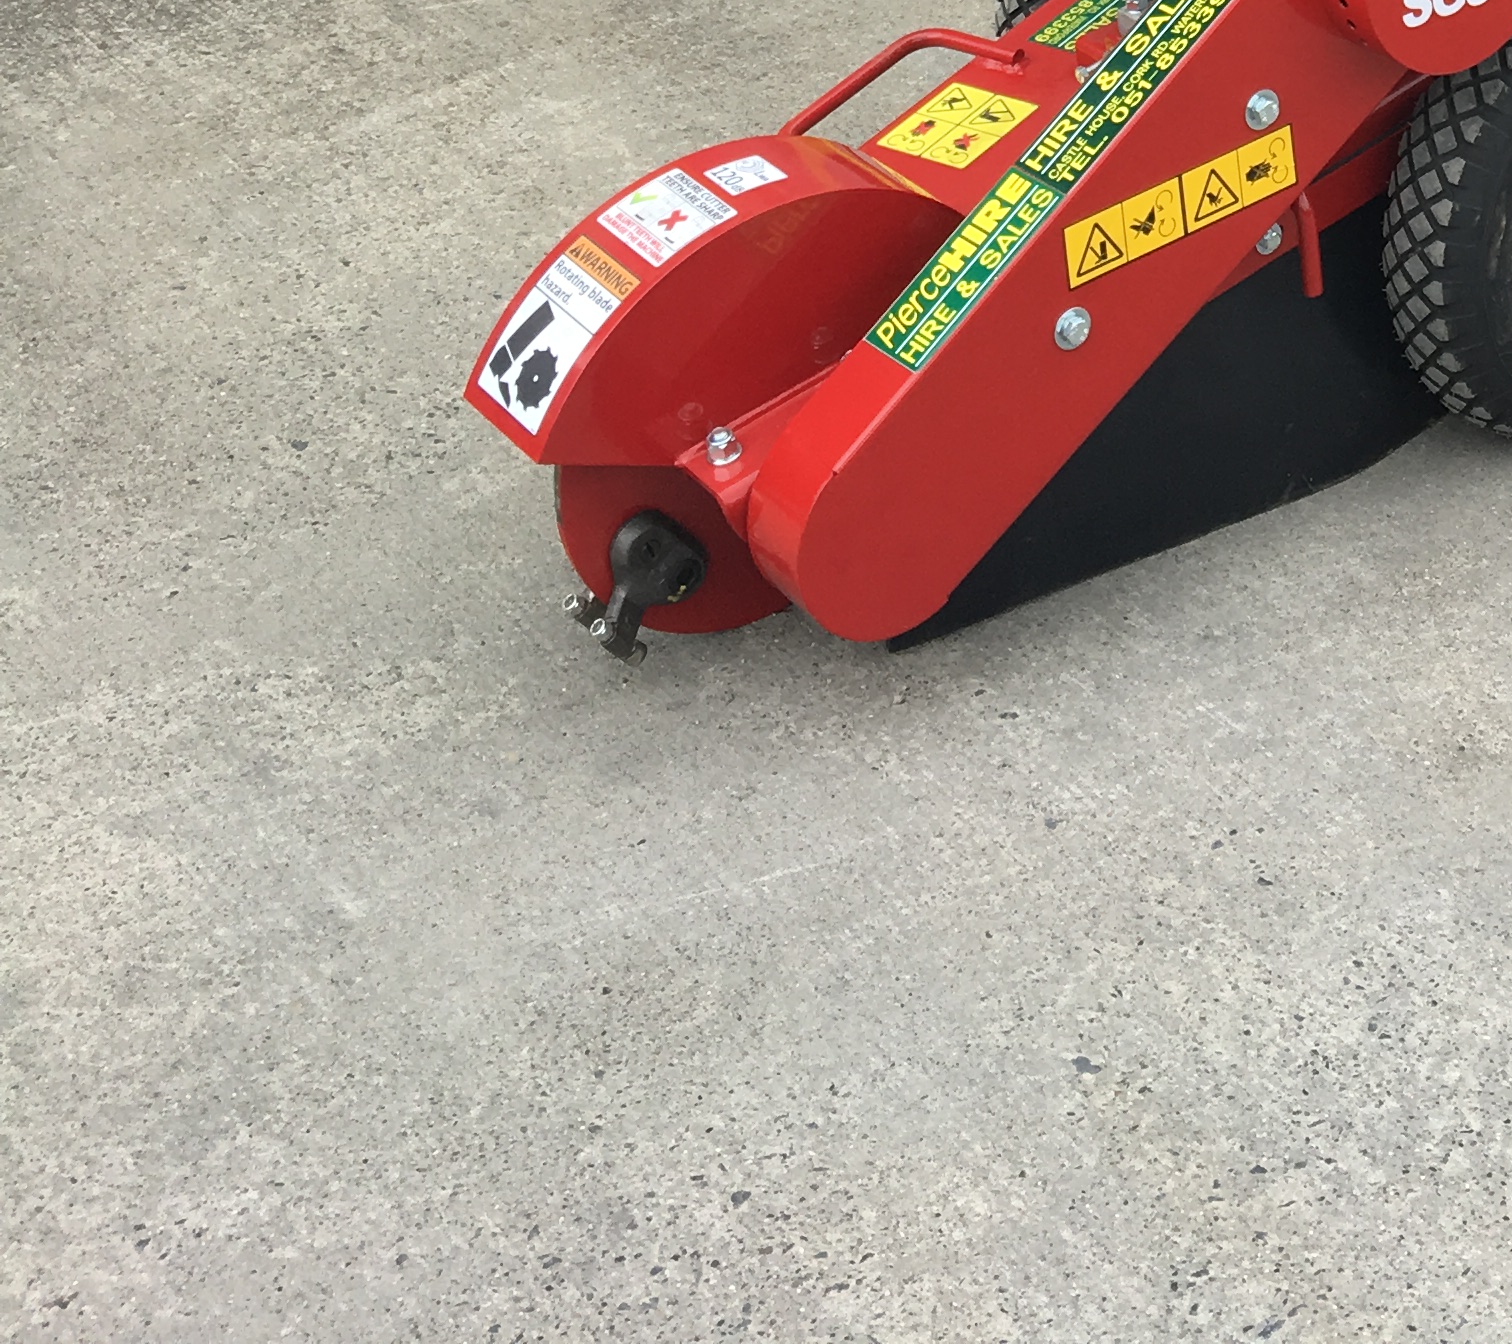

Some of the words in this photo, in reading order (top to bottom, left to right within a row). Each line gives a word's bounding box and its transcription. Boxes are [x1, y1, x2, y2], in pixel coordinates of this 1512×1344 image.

[1025, 99, 1094, 172] HIRE
[1096, 70, 1124, 91] &
[1048, 136, 1087, 180] CASTLE
[1123, 59, 1154, 92] CORK
[1056, 135, 1109, 183] TEL.
[661, 175, 687, 193] TEETH
[684, 190, 701, 205] ARE
[696, 198, 725, 221] SHARP
[673, 172, 704, 193] ENSURE
[700, 189, 732, 215] CUTTER
[540, 273, 573, 306] hazard.
[554, 259, 590, 296] Rotating
[587, 285, 614, 313] blade
[579, 247, 634, 296] WARNING
[899, 302, 957, 364] HIRE
[956, 280, 981, 299] &
[979, 188, 1054, 269] SALES
